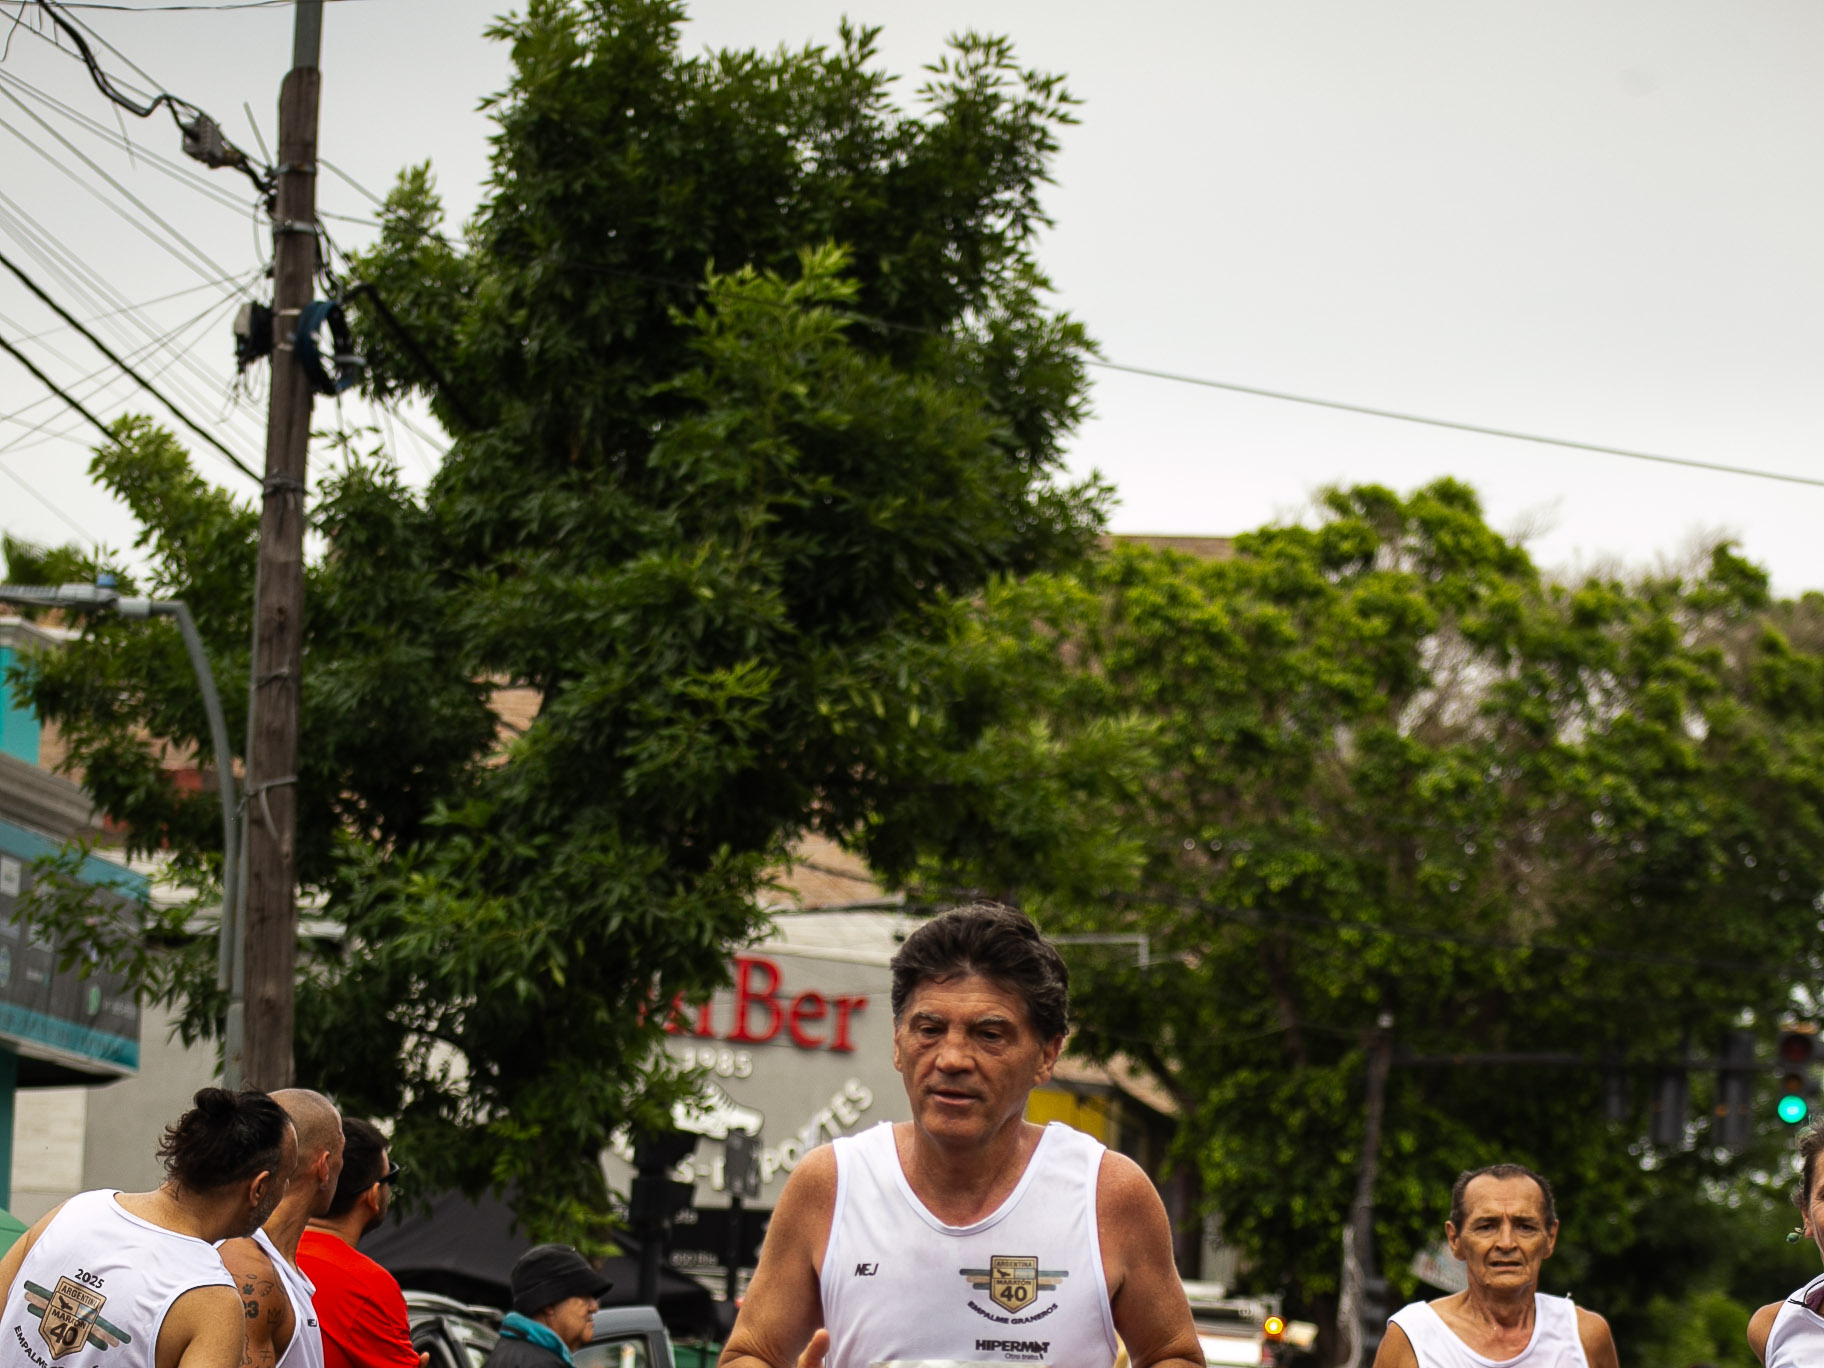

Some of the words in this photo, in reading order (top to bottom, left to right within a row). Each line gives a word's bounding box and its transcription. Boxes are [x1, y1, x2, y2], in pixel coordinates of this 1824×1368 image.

[74, 1268, 104, 1288] 2025
[1000, 1286, 1027, 1302] 40
[968, 1301, 1009, 1324] EMPALME
[1011, 1303, 1058, 1325] GRANEROS
[50, 1322, 78, 1346] 40
